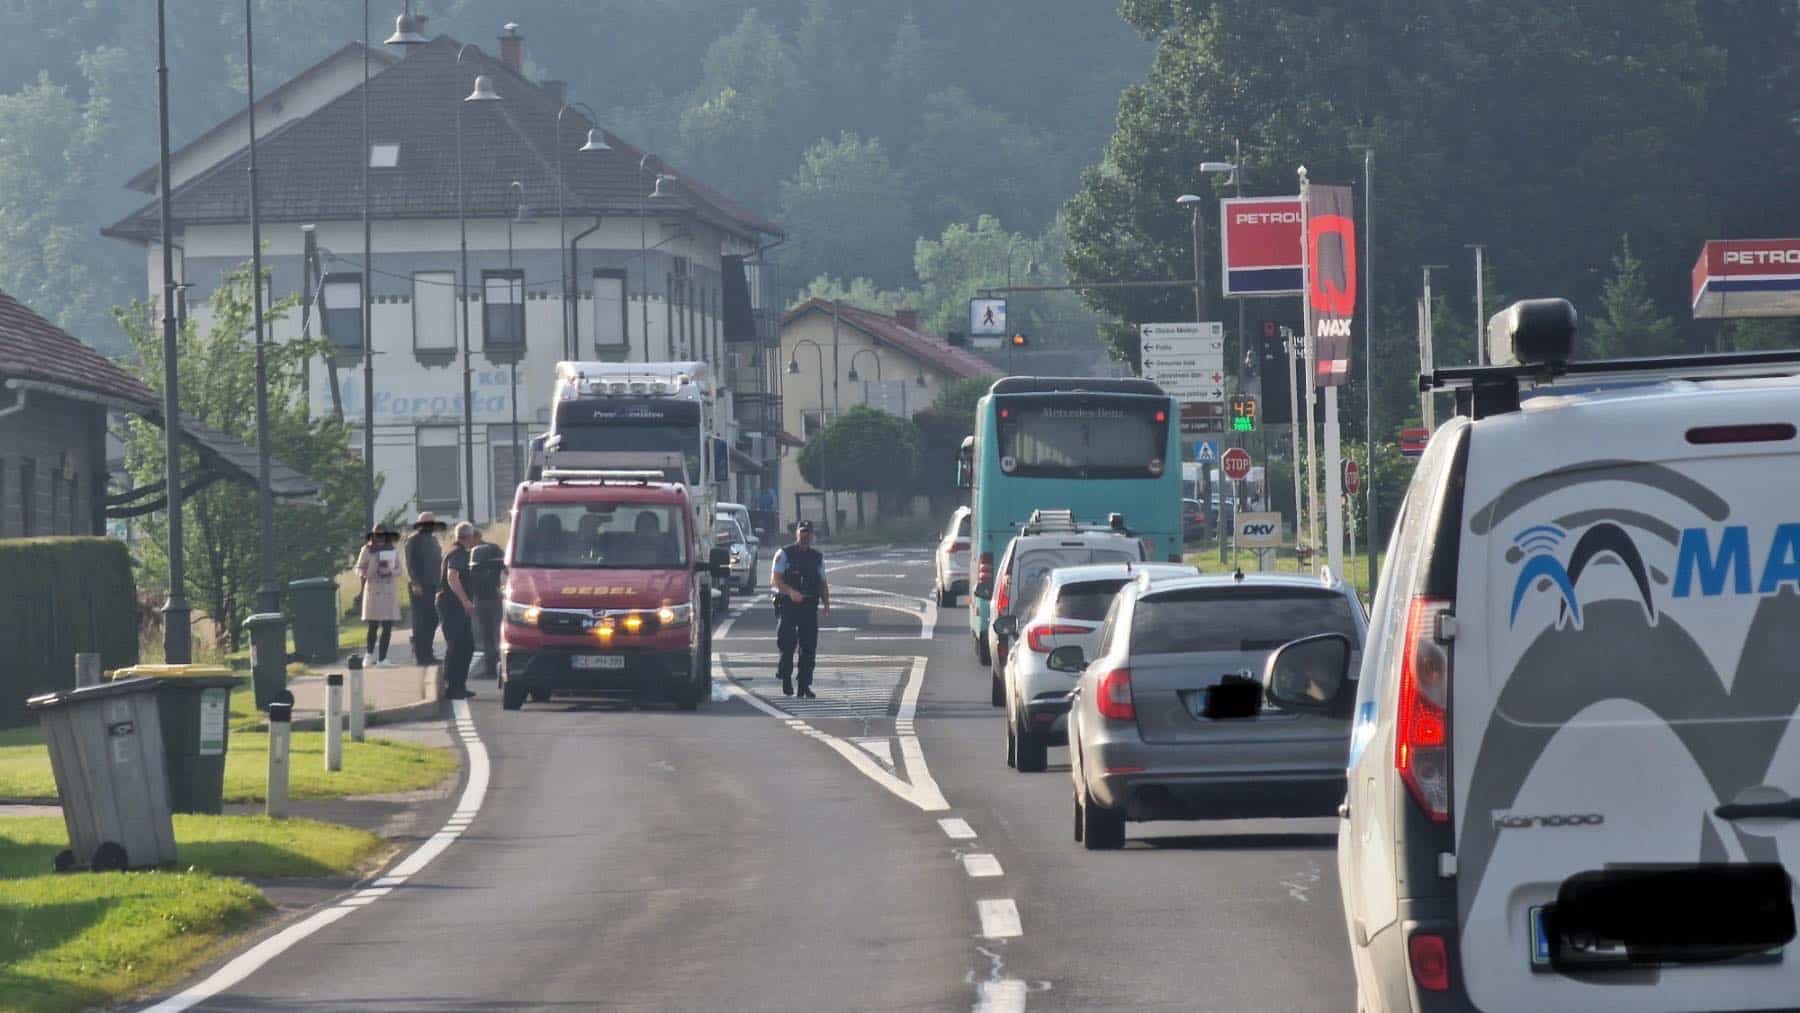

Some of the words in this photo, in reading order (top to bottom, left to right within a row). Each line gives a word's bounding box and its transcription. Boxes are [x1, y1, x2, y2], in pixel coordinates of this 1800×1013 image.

[1724, 249, 1800, 265] PETRO
[1234, 400, 1255, 416] 43
[1225, 458, 1249, 472] STOP
[1243, 524, 1274, 536] DKV
